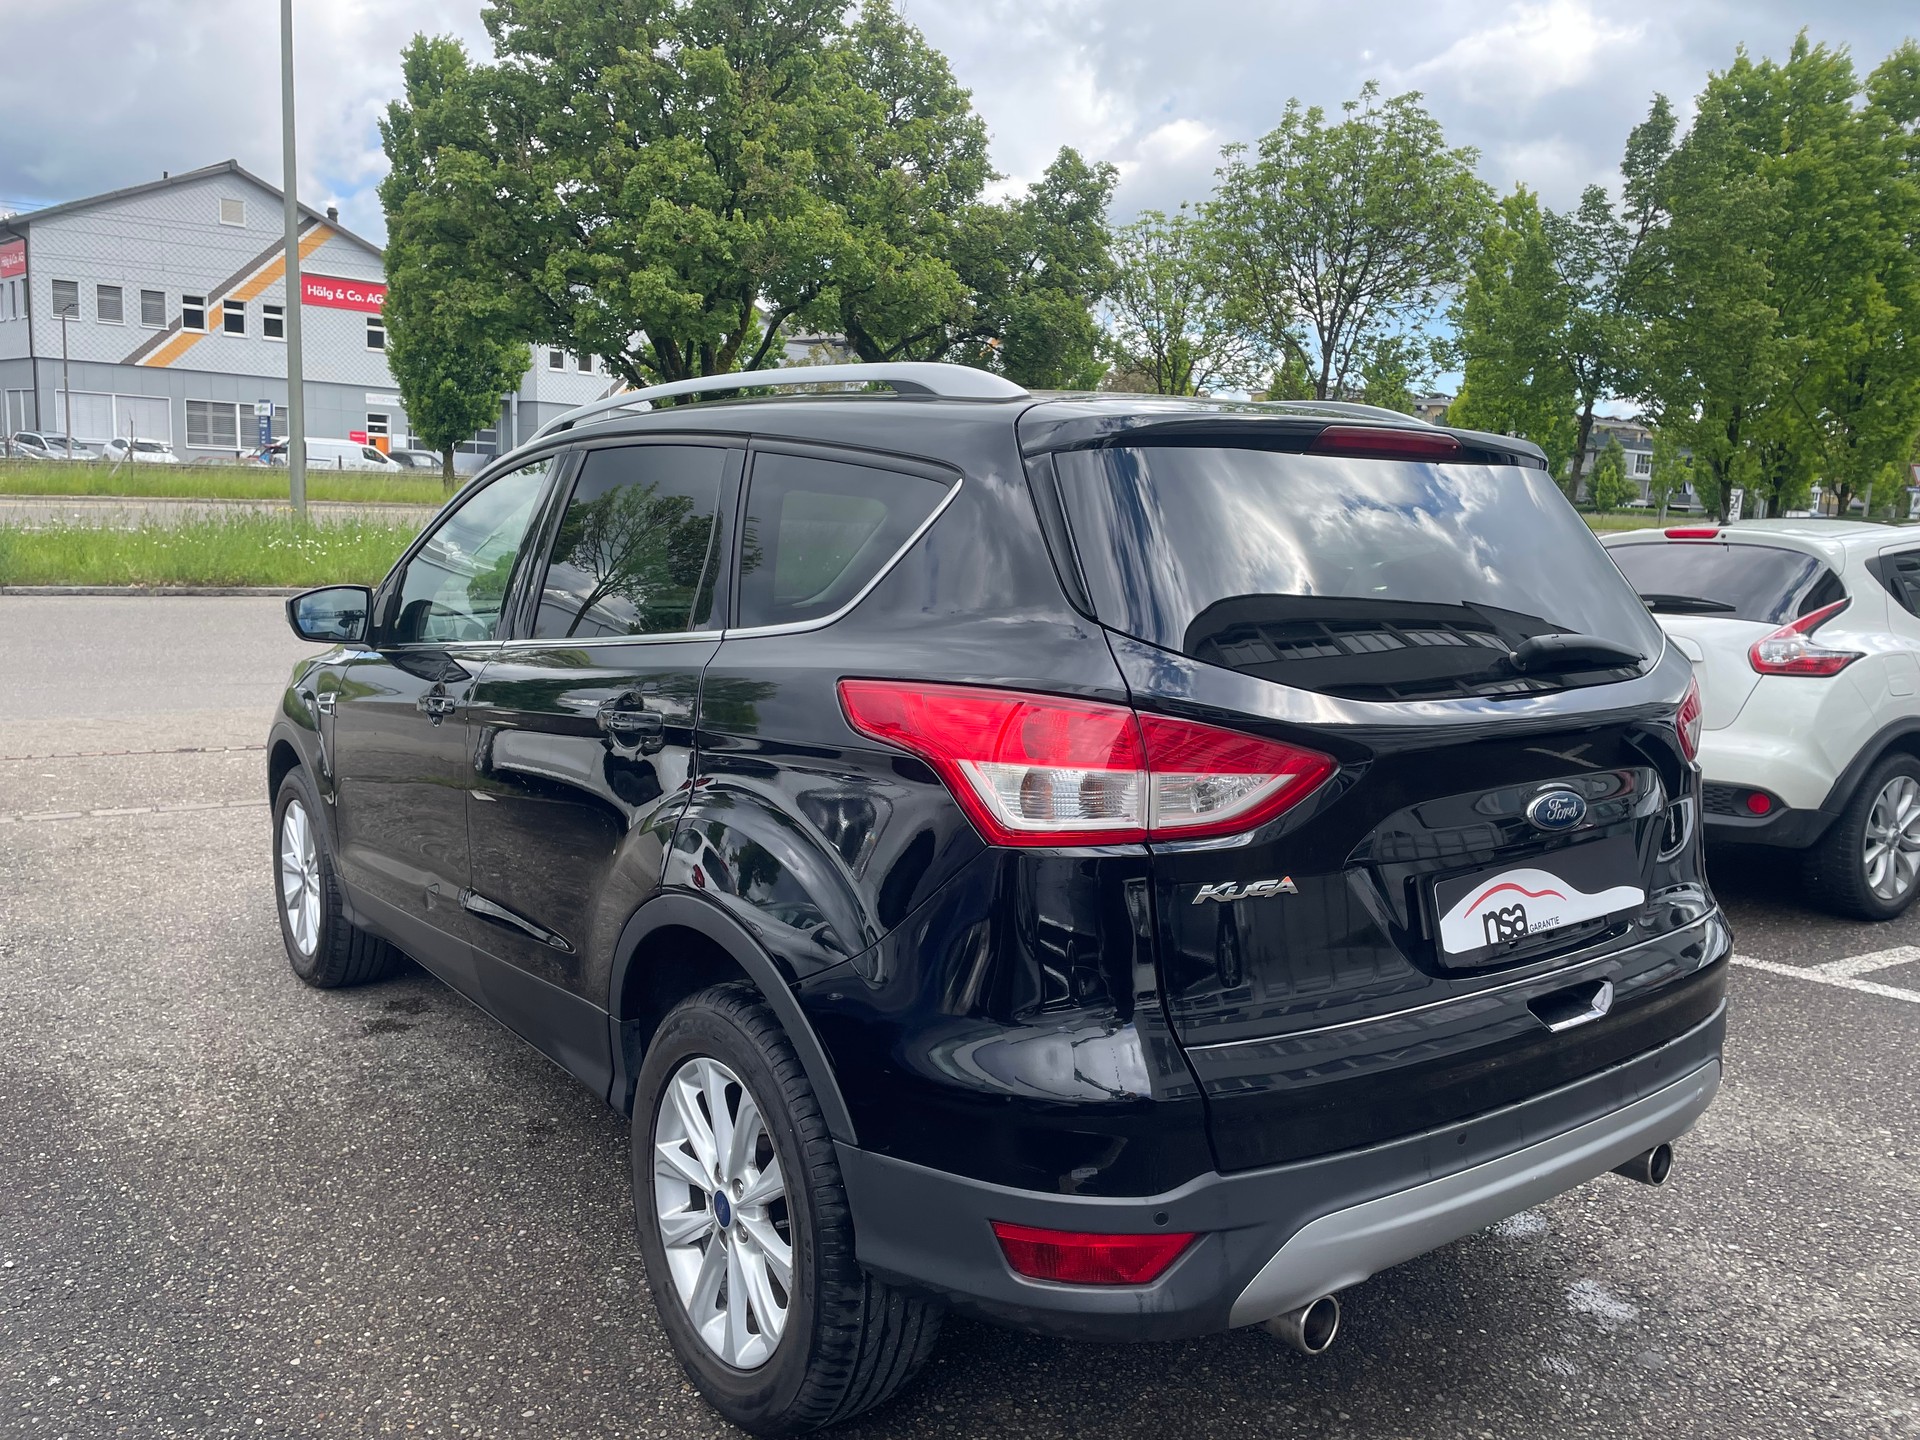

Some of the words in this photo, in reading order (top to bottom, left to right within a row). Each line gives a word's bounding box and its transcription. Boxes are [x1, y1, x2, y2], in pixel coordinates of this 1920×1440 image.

[307, 284, 333, 300] Hälg
[336, 289, 345, 299] &
[346, 290, 364, 302] Co.
[366, 293, 384, 304] AG
[1547, 798, 1577, 821] Ford
[1191, 876, 1299, 905] KUGA
[1482, 903, 1529, 945] nsa
[1529, 915, 1561, 933] GARANTIE
